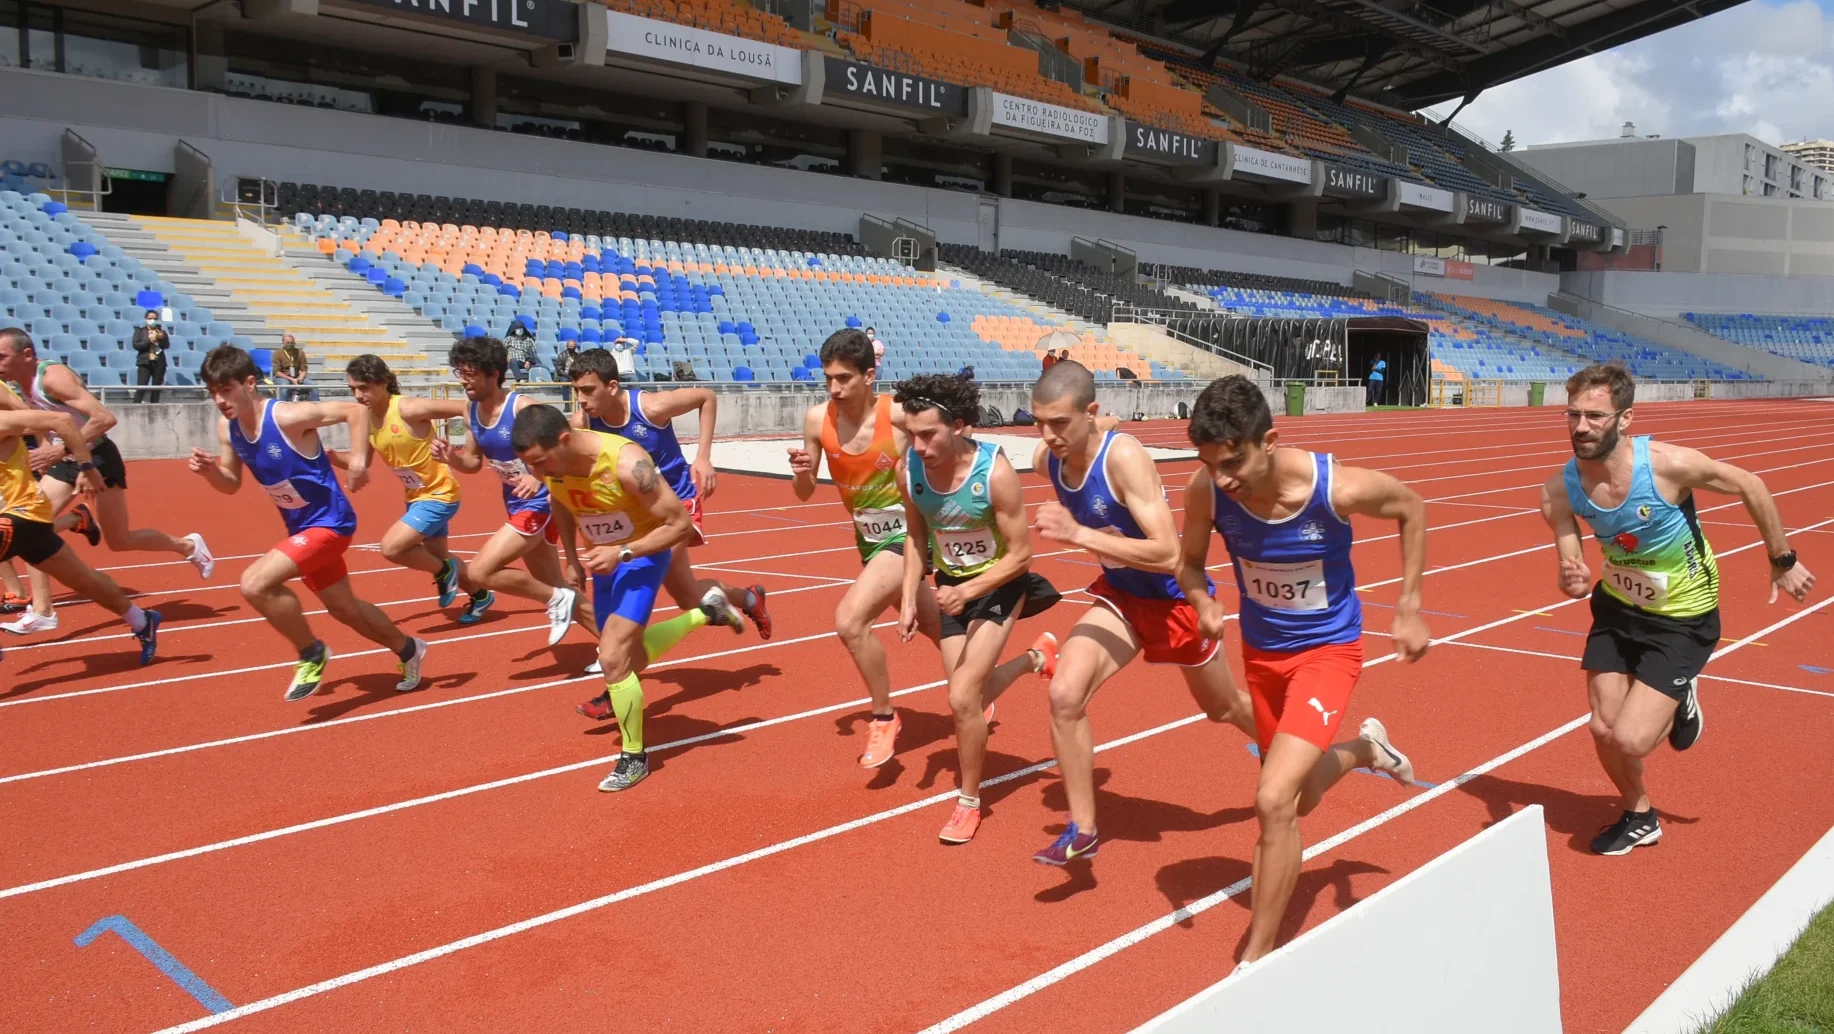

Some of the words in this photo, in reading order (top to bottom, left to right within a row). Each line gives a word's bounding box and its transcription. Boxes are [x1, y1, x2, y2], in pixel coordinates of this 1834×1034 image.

[645, 32, 700, 53] CLINICA
[707, 44, 724, 58] DA
[730, 49, 772, 67] LOUSÃ
[1003, 99, 1038, 116] CENTRO
[1042, 107, 1099, 128] RADIOLÓGICO
[1005, 111, 1017, 123] DA
[1021, 114, 1061, 131] FIGUEIRA
[1064, 123, 1075, 134] DA
[1078, 127, 1094, 138] FOZ
[1234, 153, 1259, 166] CLINICA
[1261, 159, 1268, 168] DE
[1270, 161, 1307, 176] CANTANHEDE
[1469, 199, 1502, 219] SANFIL
[1571, 222, 1597, 239] SANFIL
[585, 520, 624, 537] 1724
[863, 518, 903, 535] 1044
[944, 540, 987, 557] 1225
[1252, 578, 1311, 601] 1037
[1612, 573, 1656, 601] 1012
